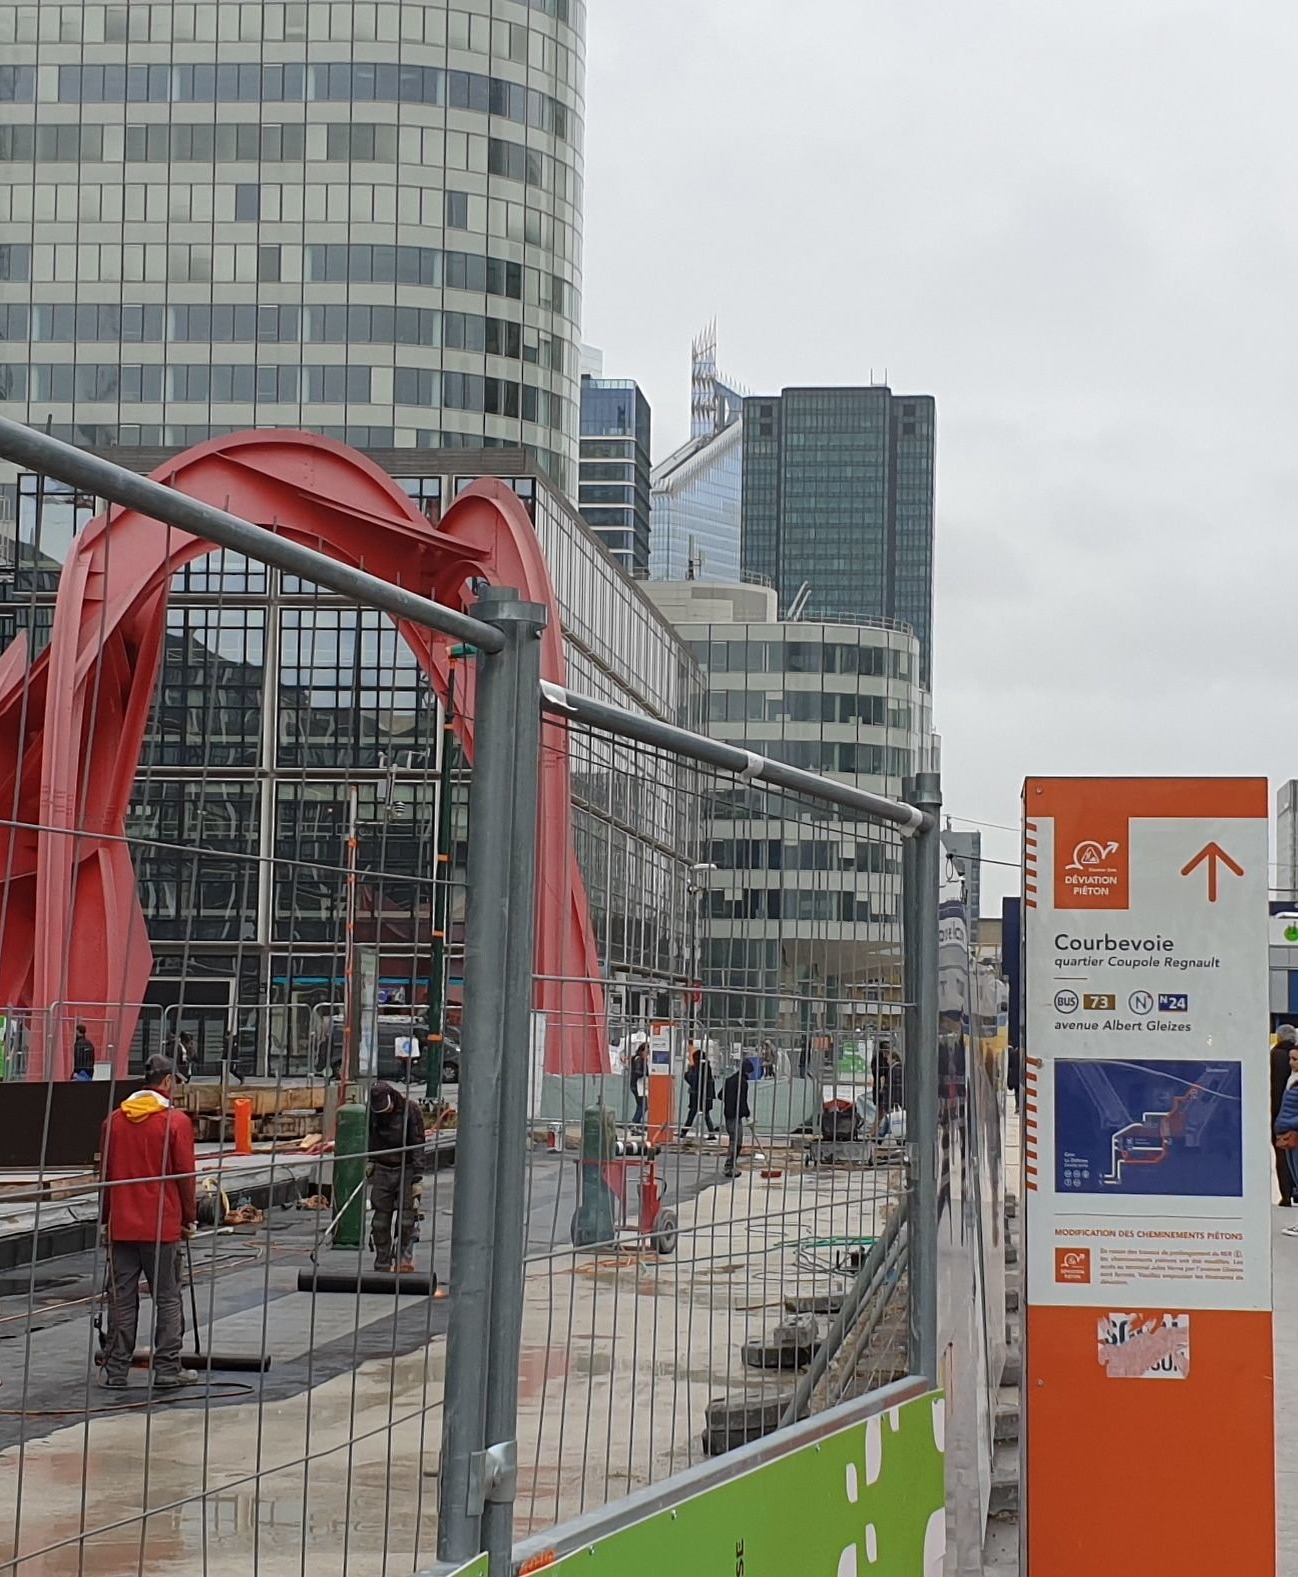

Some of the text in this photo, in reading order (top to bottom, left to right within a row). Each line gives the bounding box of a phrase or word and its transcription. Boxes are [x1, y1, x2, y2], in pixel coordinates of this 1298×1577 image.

[1065, 874, 1118, 885] DÉVIATION
[1073, 885, 1109, 896] PIÉTON
[1054, 933, 1174, 951] Courbevoie
[1054, 956, 1220, 971] quartier Coupole Regnault
[1057, 996, 1076, 1007] BUS
[1090, 996, 1109, 1009] 73
[1135, 996, 1147, 1010] N
[1054, 1019, 1192, 1032] avenue Albert Gleizes
[1054, 1228, 1243, 1242] MODIFICATION DES CHEMINEMENTS PIÉTONS
